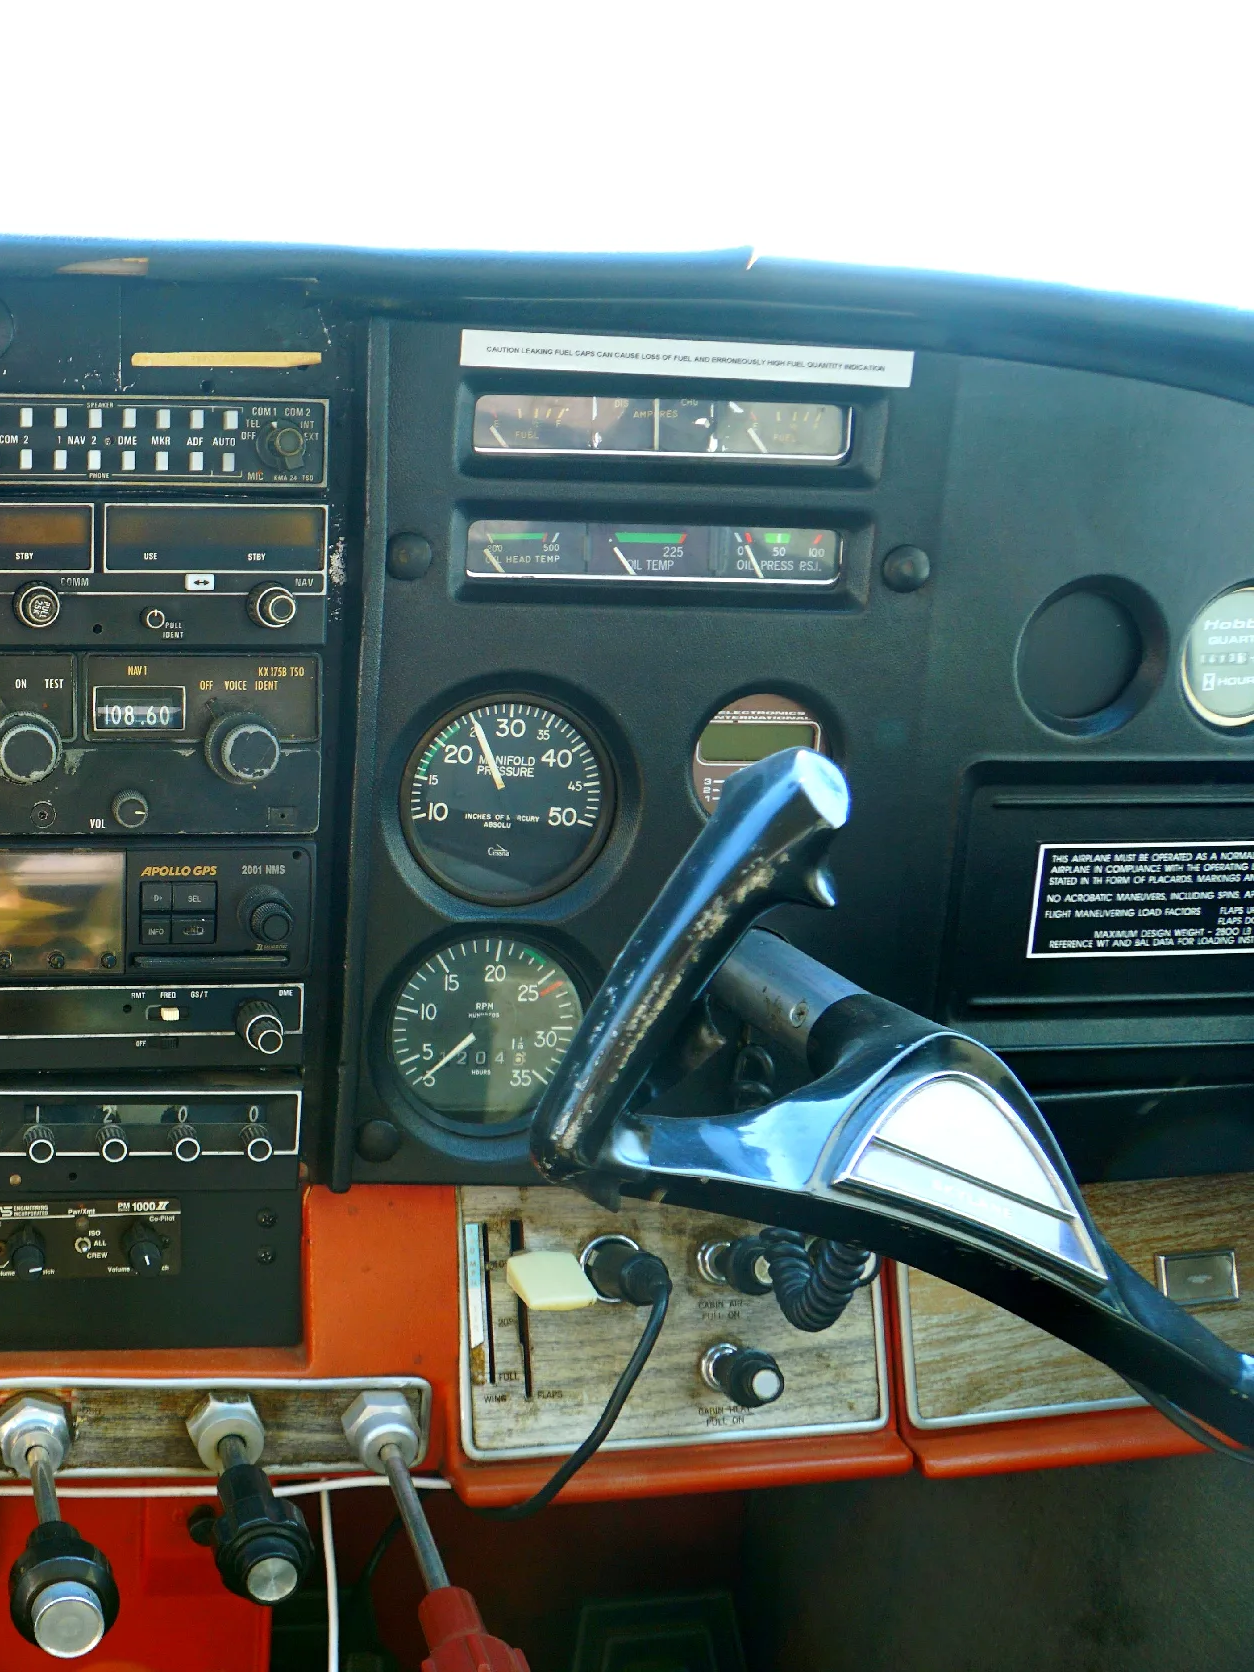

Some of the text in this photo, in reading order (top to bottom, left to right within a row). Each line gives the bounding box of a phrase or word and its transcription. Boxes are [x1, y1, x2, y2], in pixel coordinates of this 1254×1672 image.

[712, 356, 766, 366] ERRONEOUSLY
[807, 362, 842, 370] QUANTITY
[844, 364, 885, 372] INDICATION
[284, 408, 311, 416] COM 2
[246, 419, 260, 428] TEL
[0, 435, 19, 443] COM
[24, 436, 28, 444] 2
[118, 436, 137, 445] DME
[151, 436, 171, 445] MKR
[241, 432, 256, 440] OFF
[187, 437, 203, 446] ADF
[213, 437, 236, 446] AUTO
[663, 547, 683, 557] 225
[772, 547, 786, 556] 50
[737, 560, 821, 571] OIL PRESS P.S.I.
[295, 578, 314, 586] NAV
[163, 631, 184, 639] IDENT
[258, 667, 304, 677] KX 175B TSO
[15, 679, 27, 689] ON
[45, 679, 64, 689] TEST
[200, 680, 278, 690] OFF VOICE IDENT
[496, 718, 526, 737] 30
[537, 730, 550, 740] 35
[444, 745, 472, 764] 20
[541, 749, 573, 767] 40
[428, 775, 438, 785] 15
[568, 781, 582, 791] 45
[428, 803, 448, 821] 10
[548, 807, 577, 826] 50
[90, 819, 106, 829] VOL
[1052, 855, 1068, 863] THIS
[1071, 854, 1111, 862] AIRPLANE
[1114, 854, 1136, 862] MUST
[1151, 853, 1193, 861] OPERATED
[141, 866, 217, 876] APOLLO GPS
[241, 865, 286, 875] 2001 NMS
[1050, 865, 1091, 873] AIRPLANE
[1094, 865, 1102, 873] IN
[1105, 864, 1162, 873] COMPLIANCE
[1164, 864, 1184, 872] WITH
[1203, 863, 1249, 871] OPERATING
[188, 895, 201, 903] SEL
[1045, 910, 1071, 918] FLIGHT
[1074, 909, 1135, 918] MANEUVERING
[1165, 907, 1201, 915] FACTORS
[1219, 907, 1244, 915] FLAPS
[485, 965, 506, 982] 20
[445, 975, 459, 991] 15
[518, 984, 539, 1001] 25
[421, 1004, 437, 1020] 10
[534, 1031, 557, 1047] 30
[510, 1070, 532, 1086] 35
